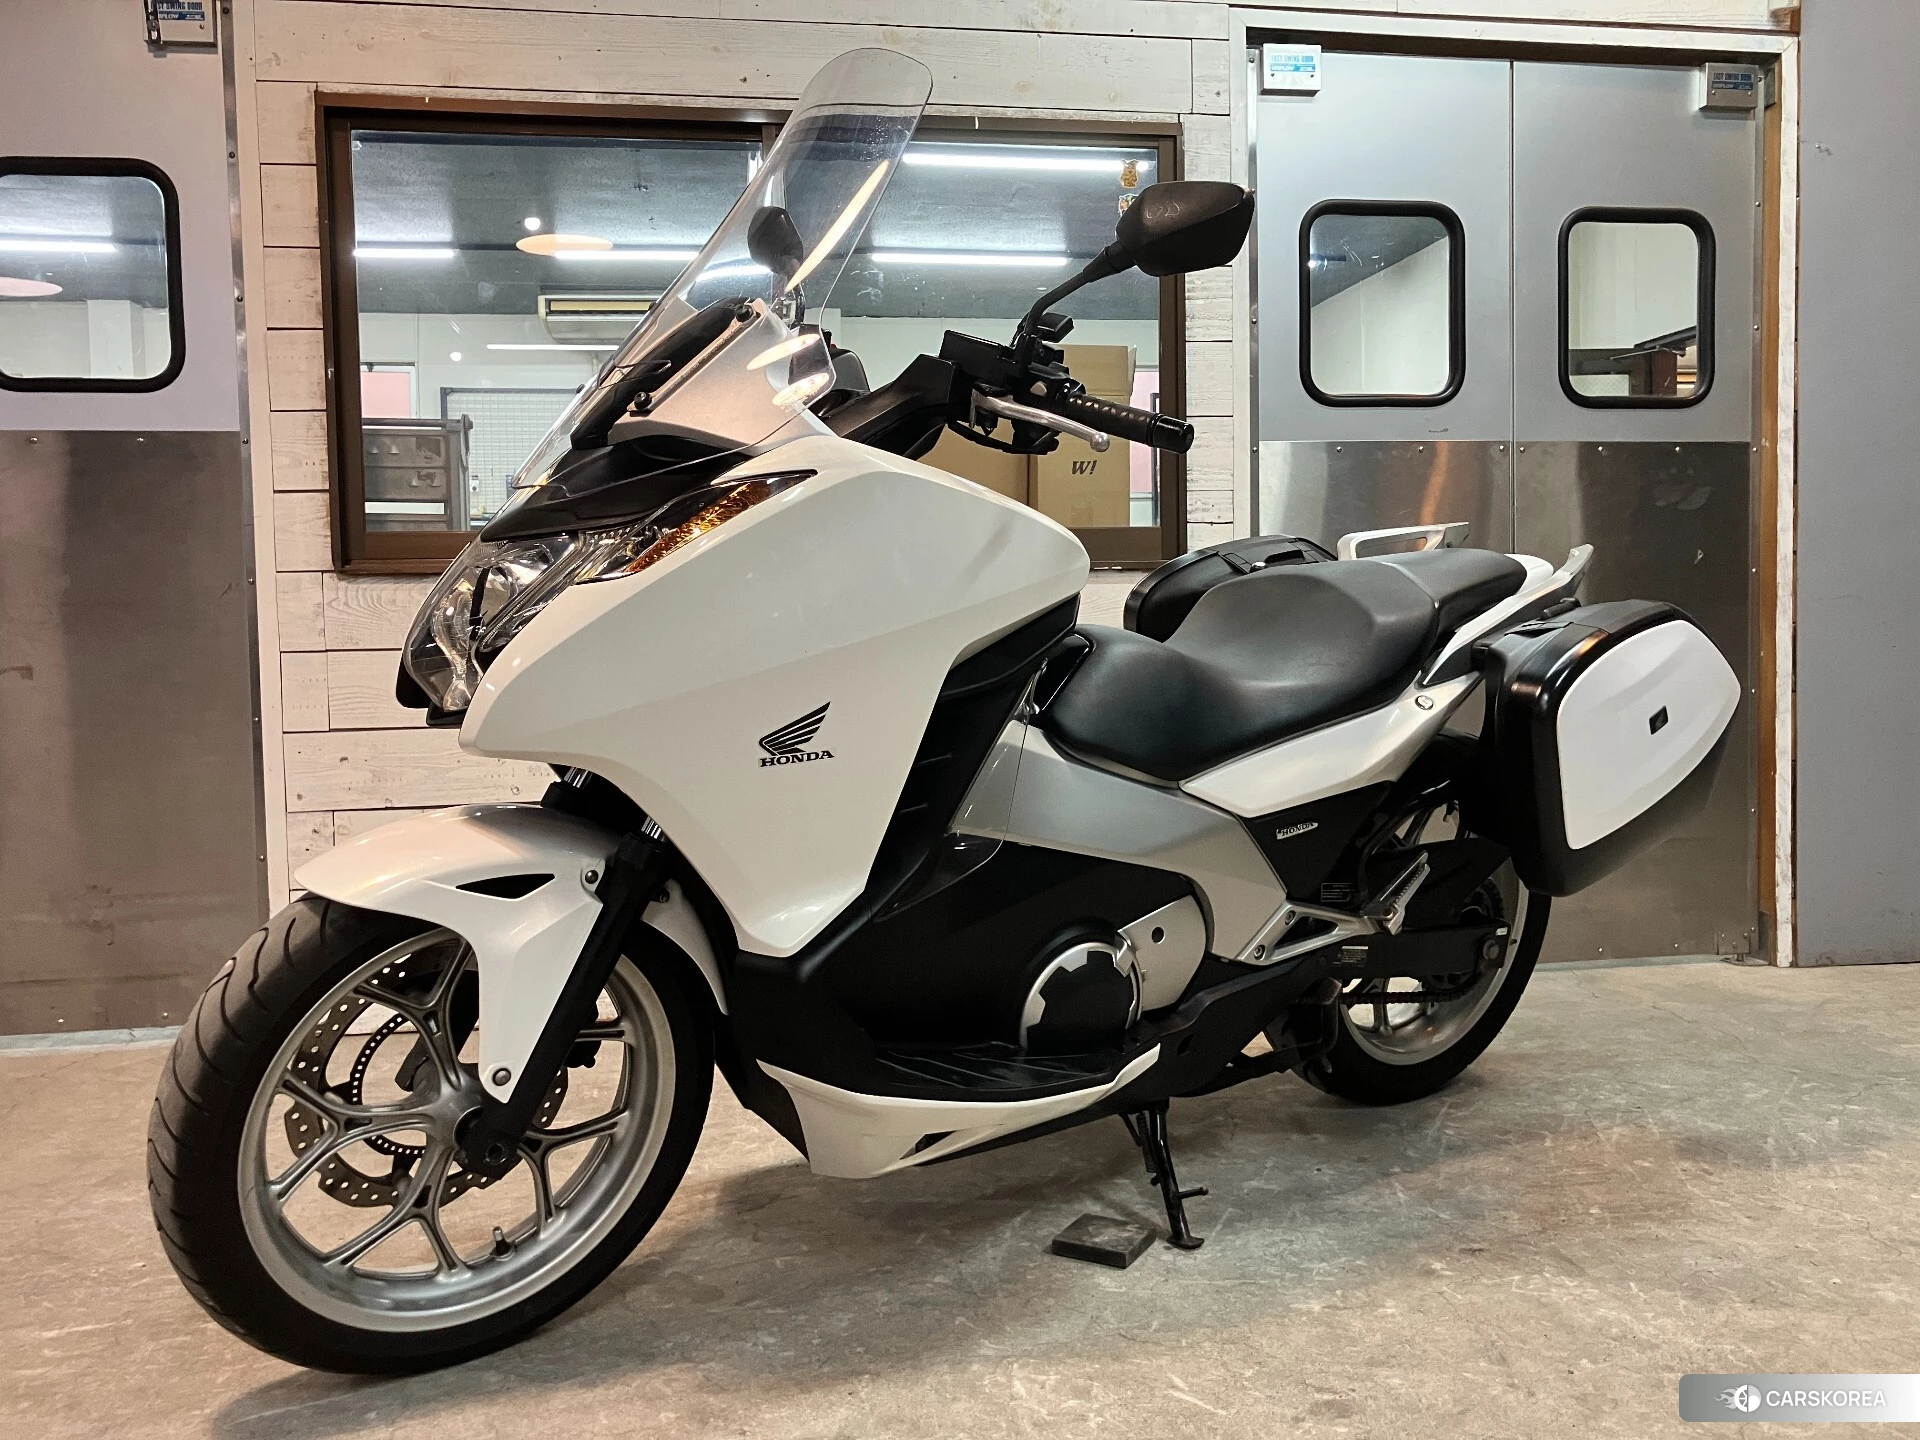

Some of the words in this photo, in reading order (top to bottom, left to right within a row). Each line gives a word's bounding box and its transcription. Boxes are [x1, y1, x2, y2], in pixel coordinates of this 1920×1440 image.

[1072, 460, 1098, 475] W!
[760, 750, 835, 767] HONDA
[1281, 822, 1315, 836] HONDA
